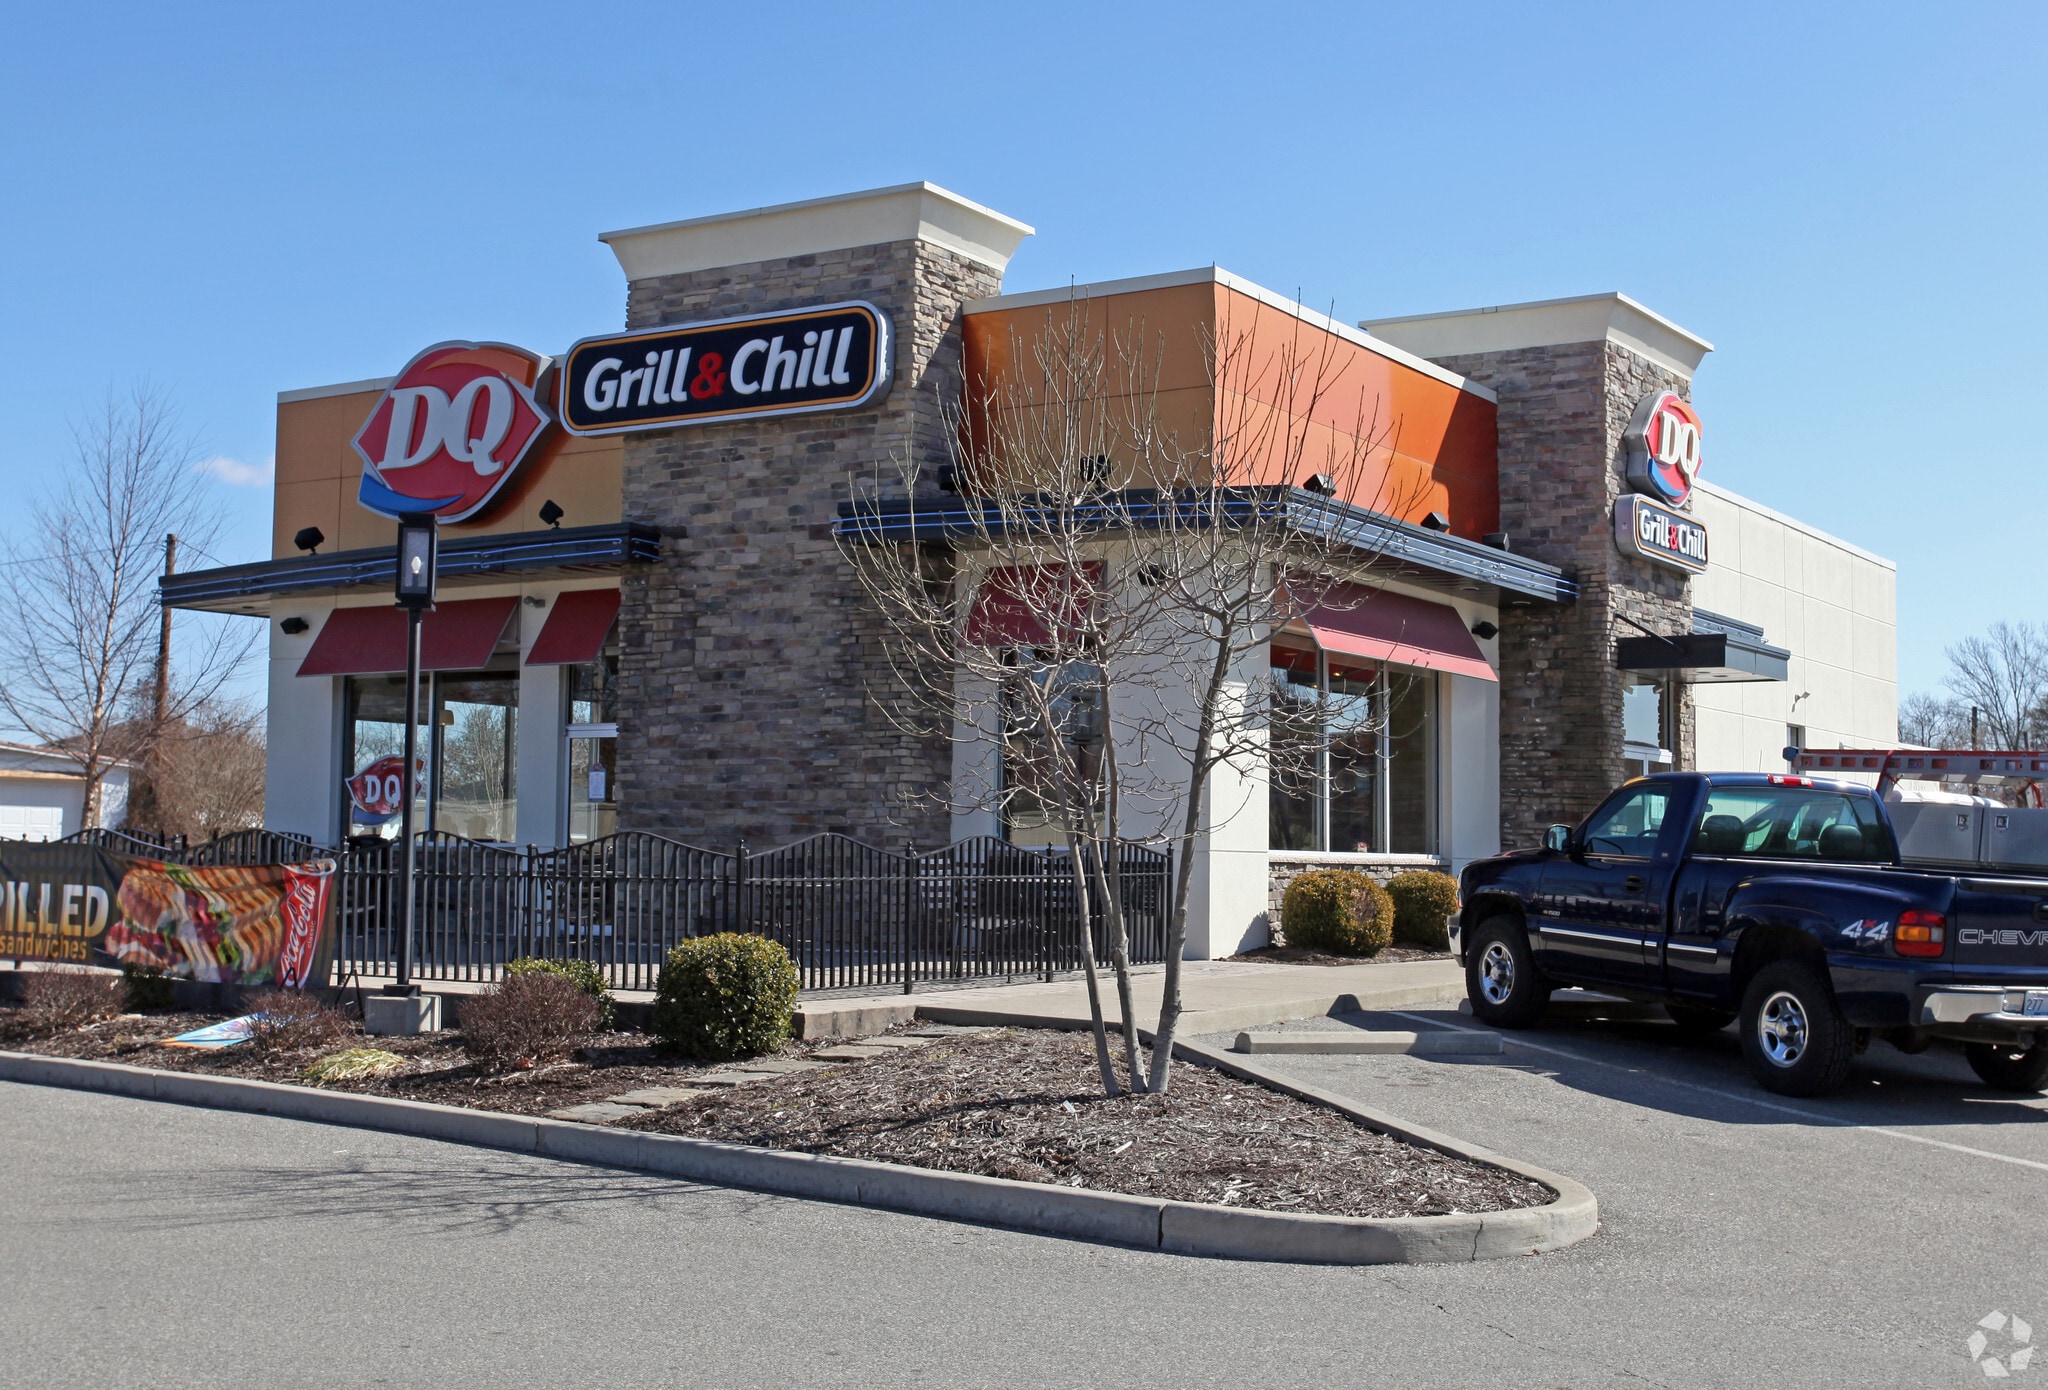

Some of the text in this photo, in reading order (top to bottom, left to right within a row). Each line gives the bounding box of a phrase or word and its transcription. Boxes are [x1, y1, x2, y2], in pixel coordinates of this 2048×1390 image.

[377, 376, 515, 476] DQ
[1656, 410, 1700, 487] DQ
[364, 774, 401, 809] DQ
[0, 881, 109, 938] ILLED
